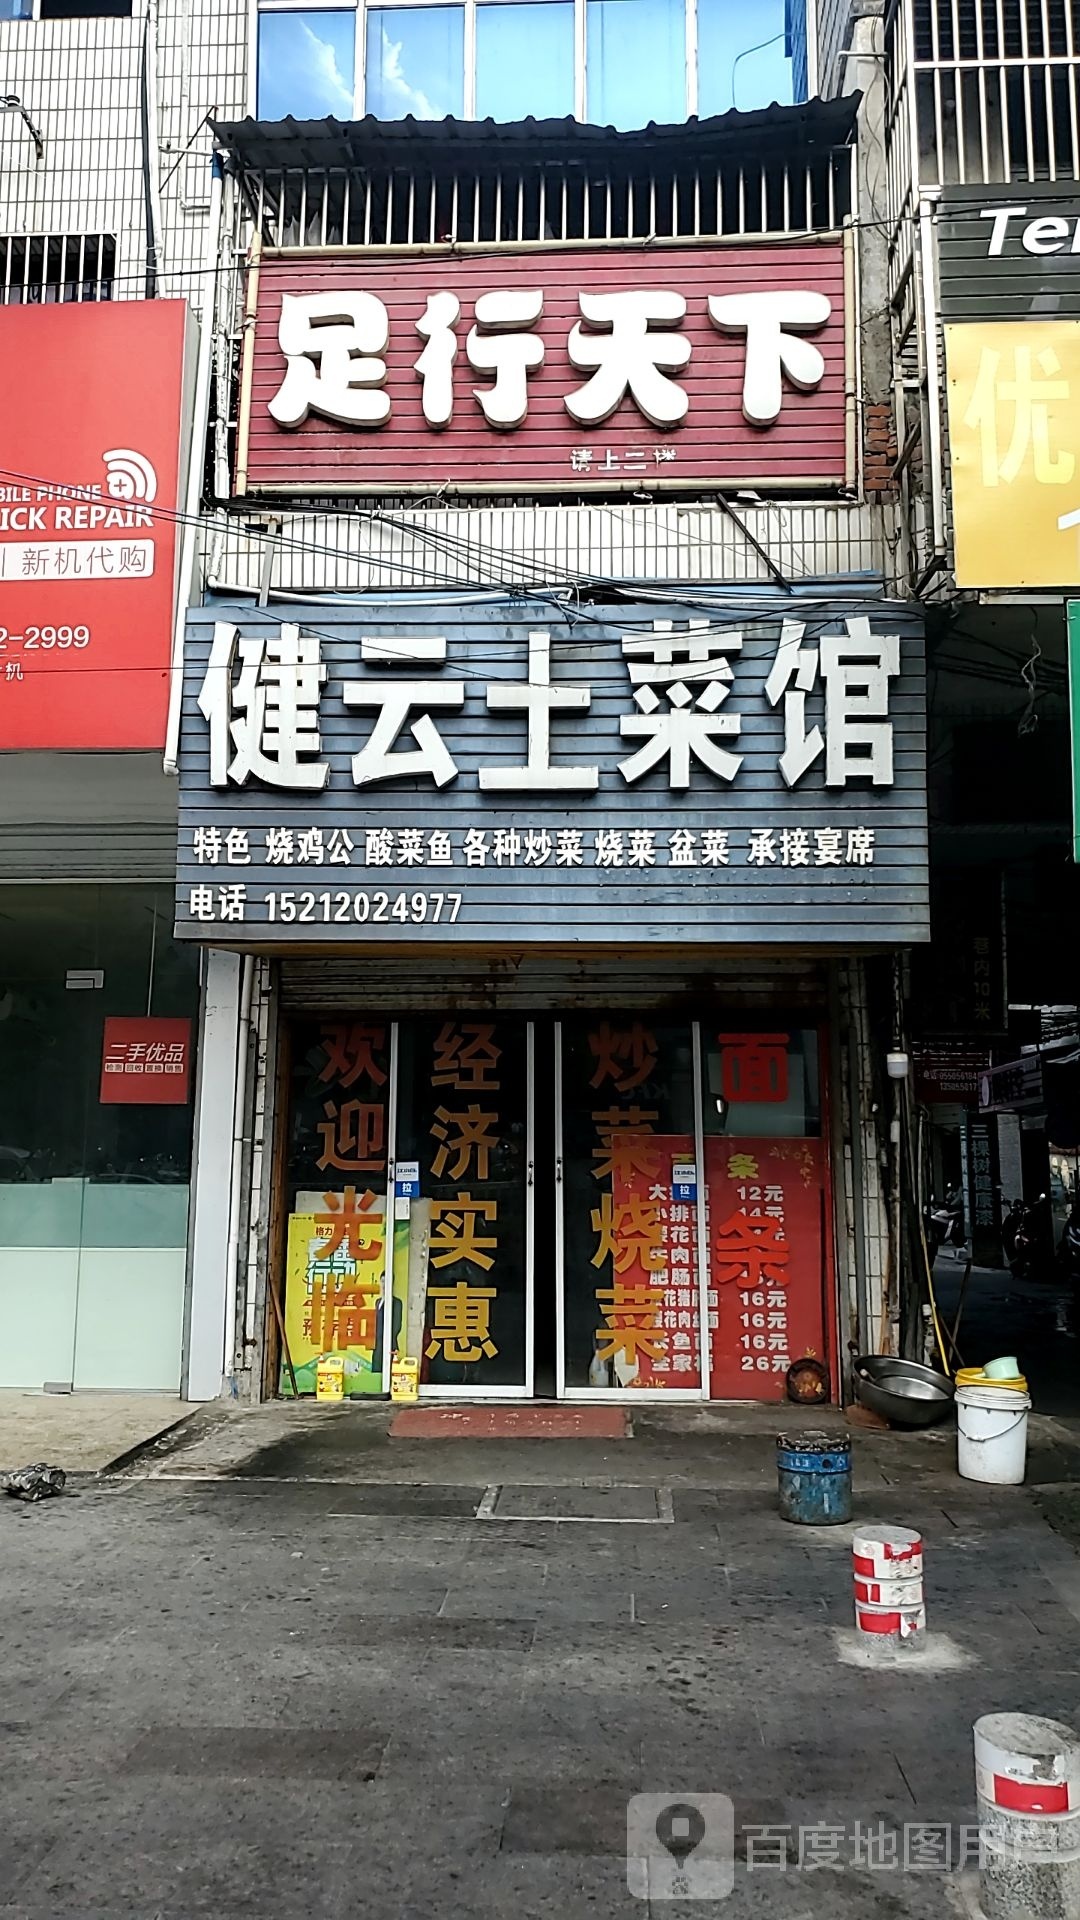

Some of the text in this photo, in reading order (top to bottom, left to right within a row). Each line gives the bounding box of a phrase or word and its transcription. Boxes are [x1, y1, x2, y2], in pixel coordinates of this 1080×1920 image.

[268, 290, 832, 428] 足行天下
[963, 345, 1075, 487] 优
[570, 449, 677, 472] 请上二楼
[36, 485, 102, 501] PHONE
[55, 504, 154, 530] REPAIR
[22, 545, 147, 576] 新机代购
[0, 661, 24, 681] 机
[196, 617, 901, 790] 健云土菜馆
[193, 826, 876, 867] 特色 烧鸡公 酸菜鱼 各种炒菜 烧菜 盆菜 承接宴席
[189, 884, 463, 923] 电话 15212024977
[105, 1042, 185, 1062] 二手优品
[716, 1033, 790, 1289] 面条
[315, 1023, 388, 1353] 欢迎光临
[402, 1182, 412, 1193] 拉
[424, 1023, 503, 1363] 经济实惠
[588, 1021, 667, 1366] 炒菜烧菜
[680, 1185, 690, 1195] 拉
[737, 1185, 783, 1201] 12元
[740, 1290, 787, 1308] 16元
[740, 1311, 787, 1329] 16元
[740, 1333, 788, 1351] 16元
[741, 1355, 791, 1372] 26元
